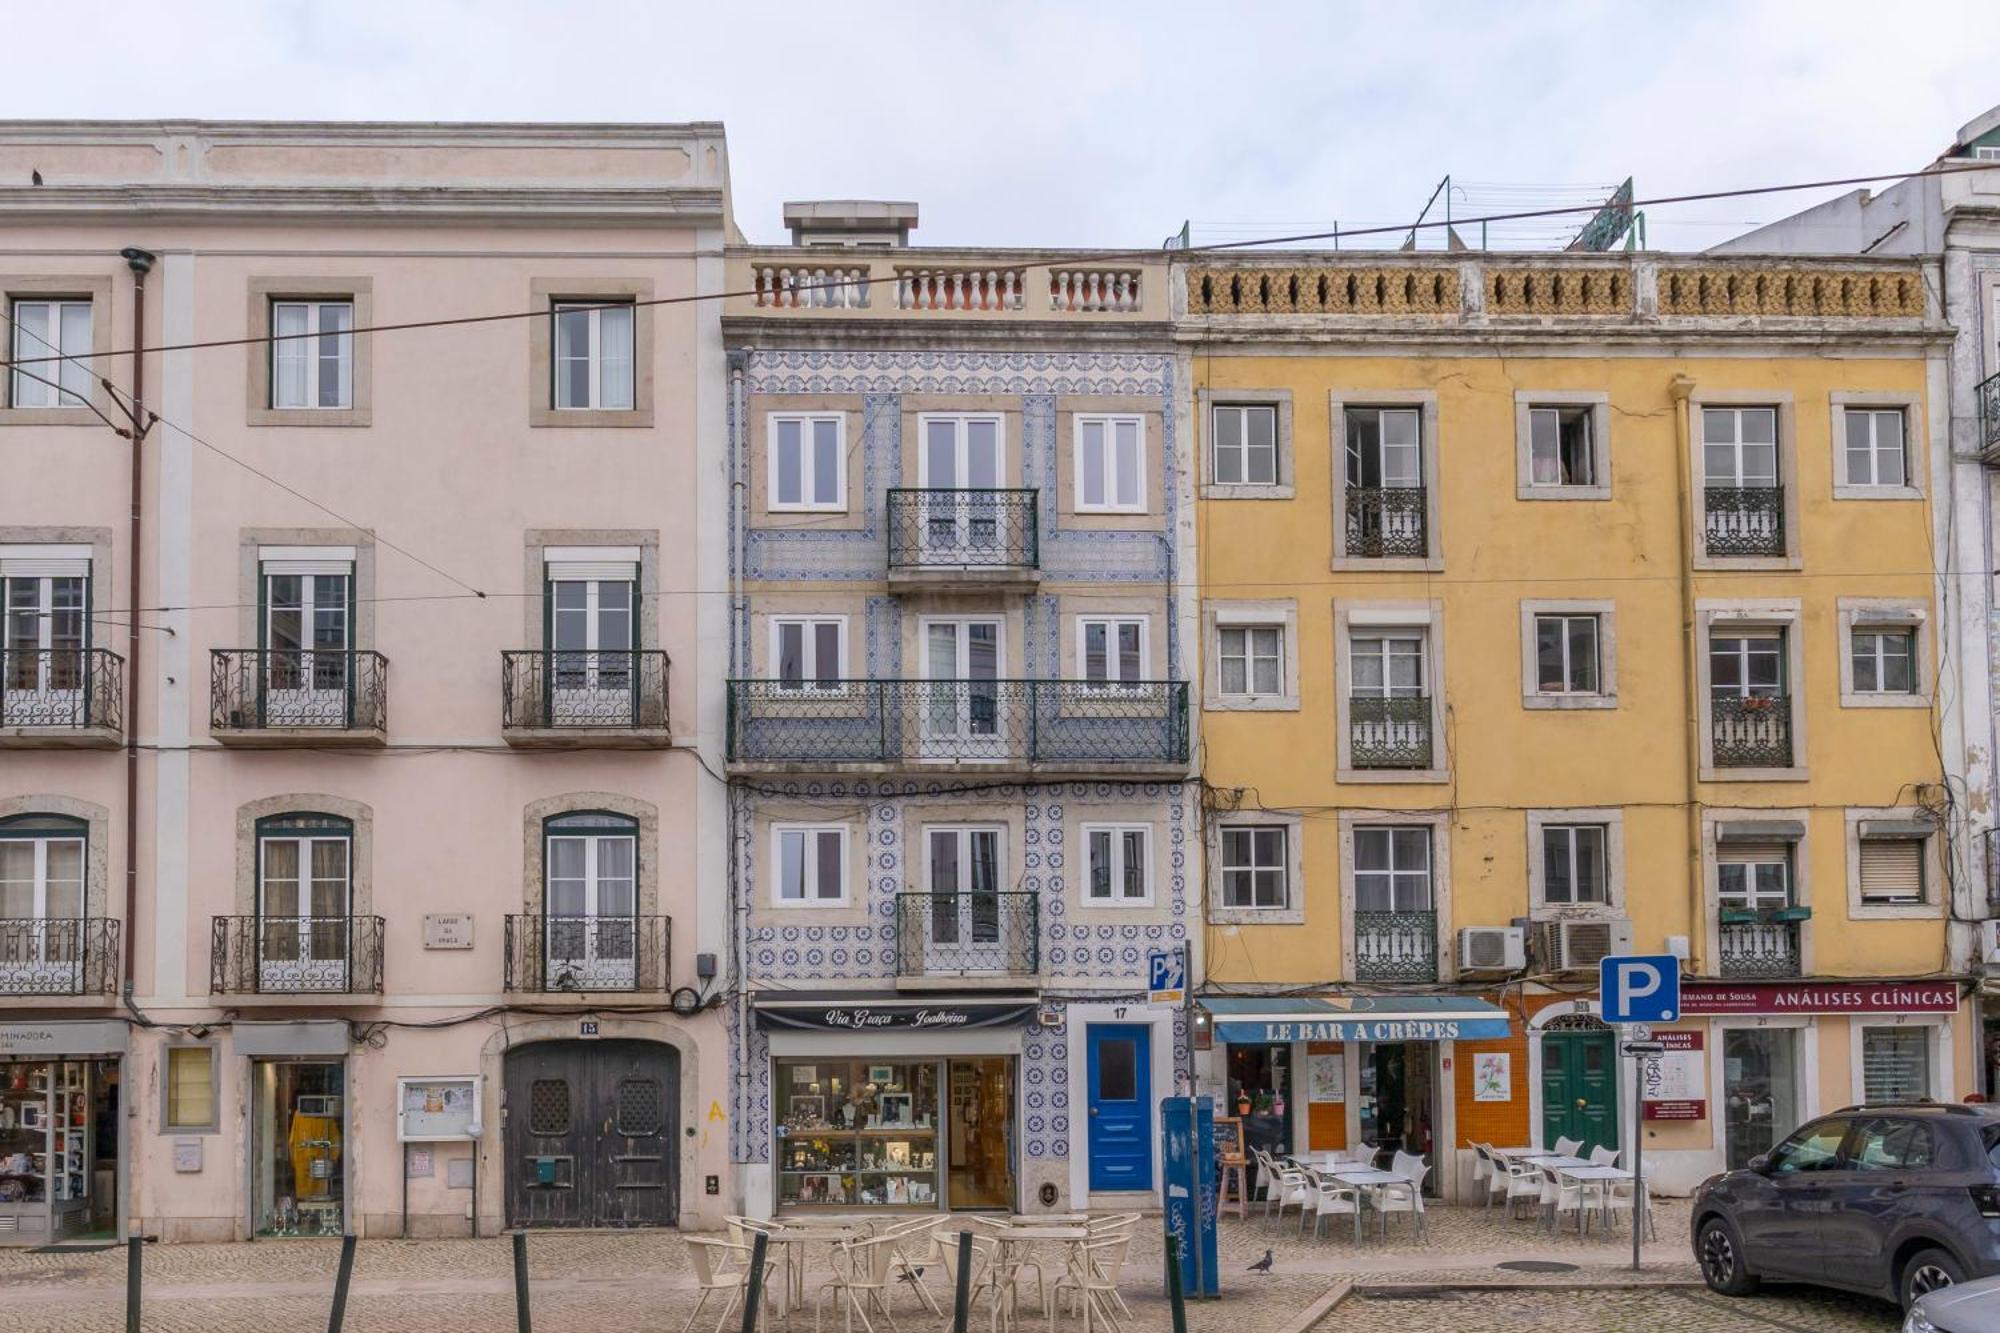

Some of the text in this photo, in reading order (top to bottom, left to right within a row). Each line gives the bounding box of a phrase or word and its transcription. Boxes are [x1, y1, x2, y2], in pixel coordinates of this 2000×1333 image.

[1153, 957, 1165, 985] P
[1617, 963, 1661, 1016] P
[1774, 988, 1954, 1006] ANÁLISES CLÍNICAS
[825, 1010, 850, 1025] Via
[852, 1010, 892, 1028] Graça
[910, 1010, 968, 1027] Joalheiros
[1114, 1007, 1127, 1019] 17
[1266, 1020, 1459, 1040] LE BAR A CRÊPES
[1657, 1033, 1692, 1041] ANÁLISES
[1664, 1041, 1692, 1049] ÍNICAS
